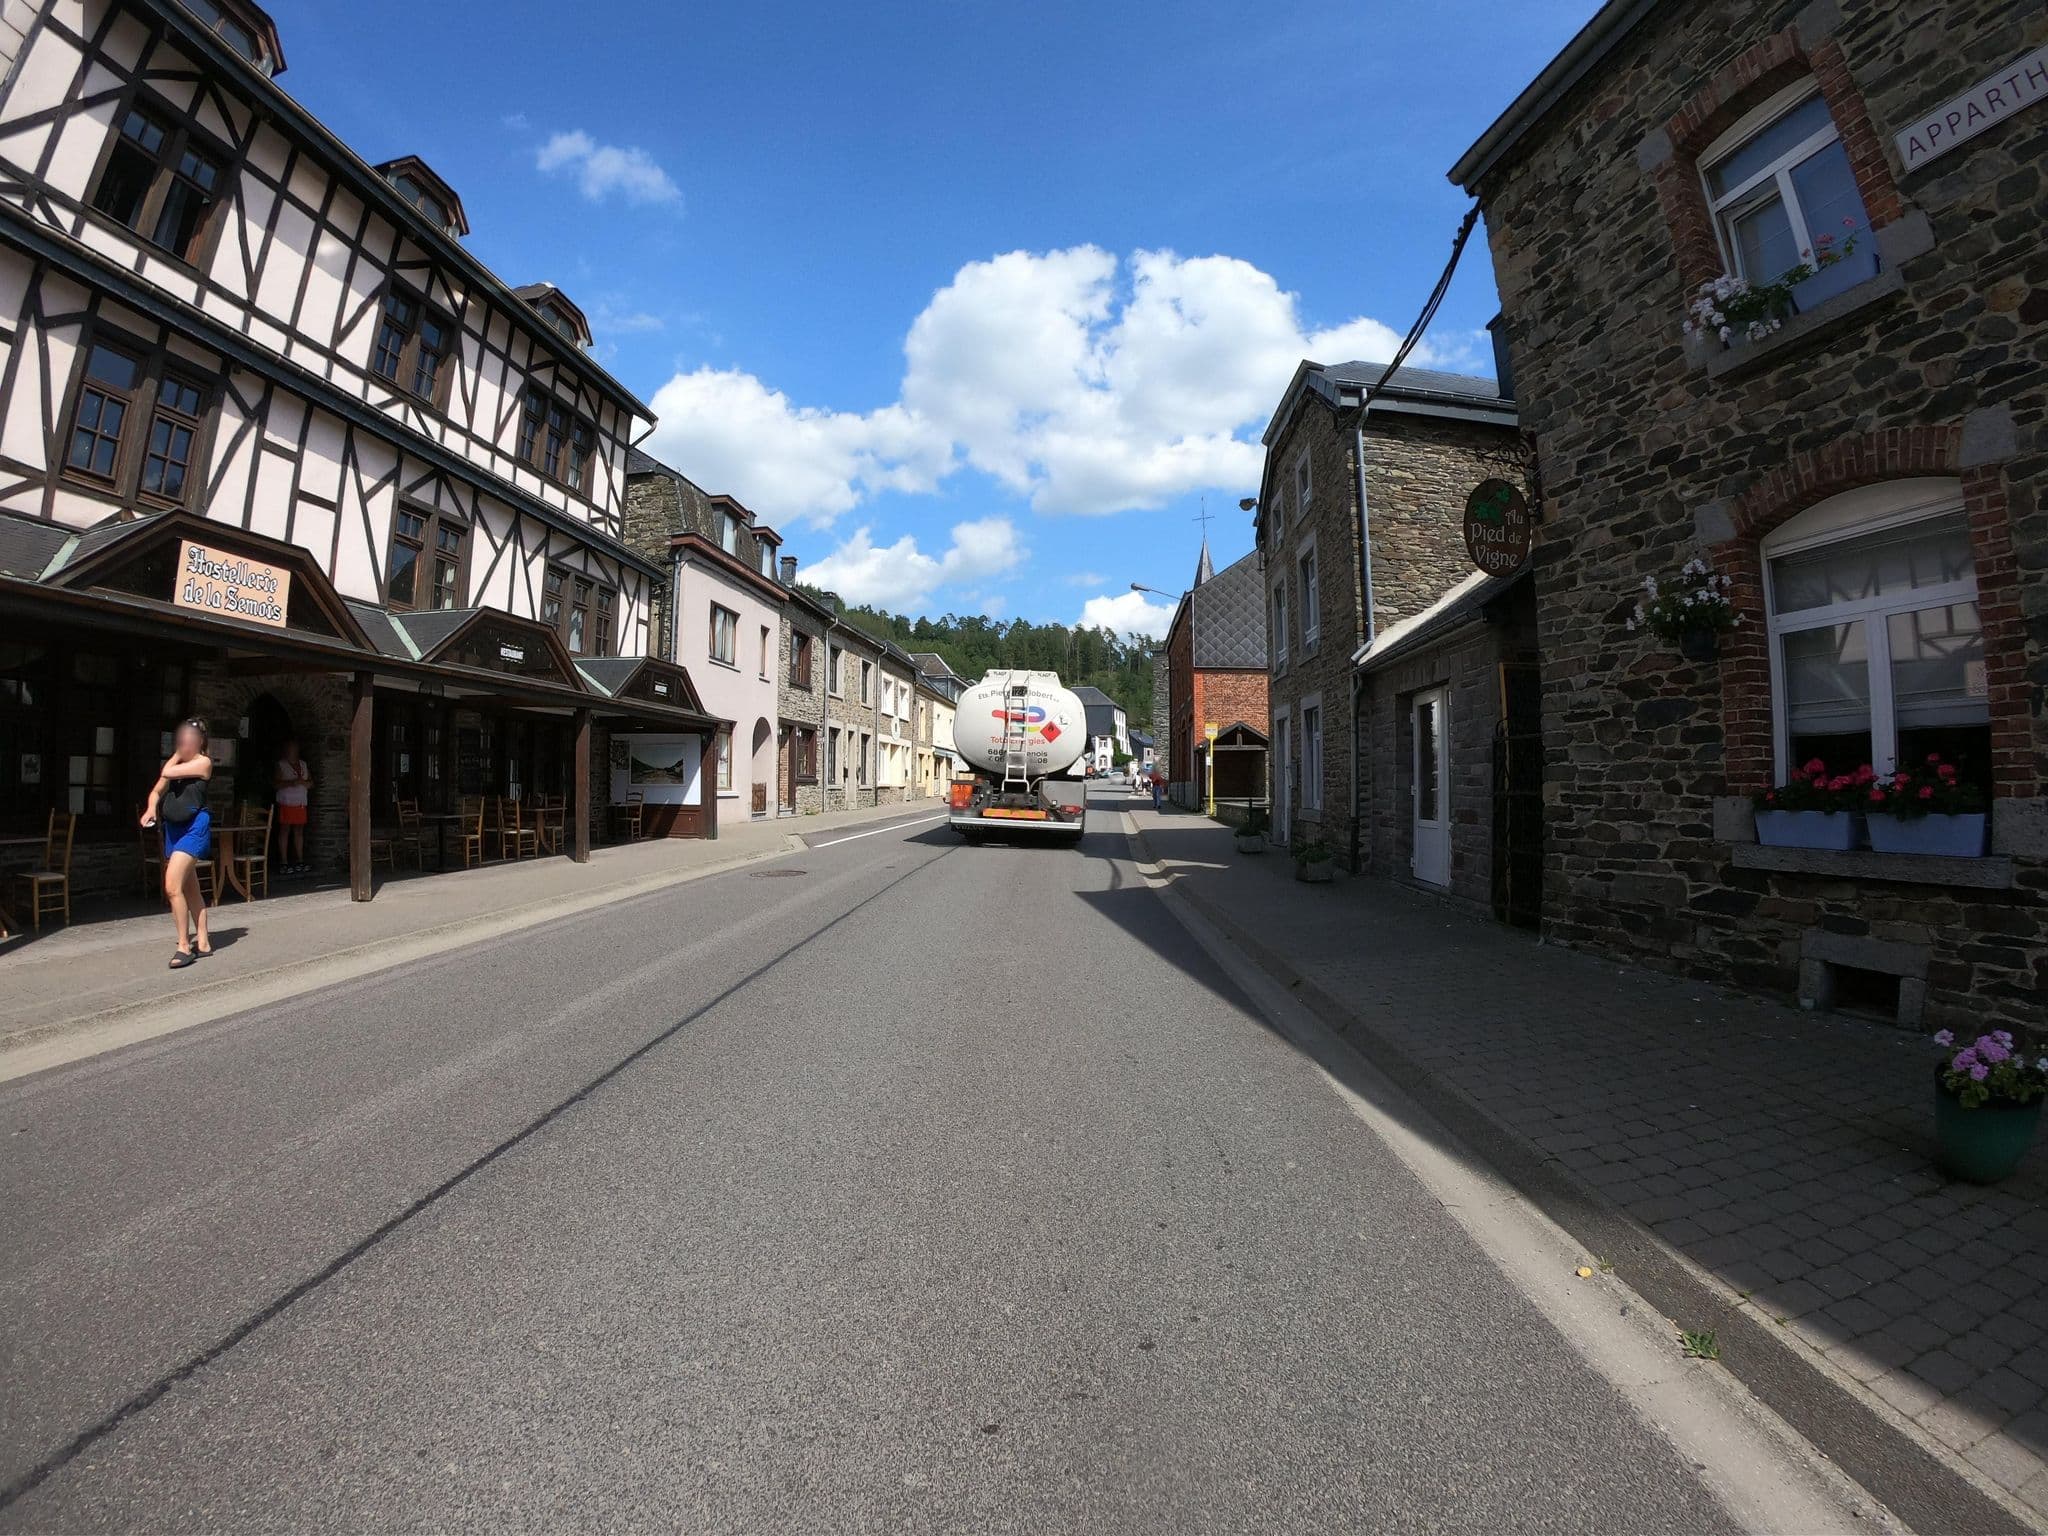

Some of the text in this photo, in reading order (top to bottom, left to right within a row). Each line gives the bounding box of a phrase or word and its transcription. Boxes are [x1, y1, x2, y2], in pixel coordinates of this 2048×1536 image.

[1909, 60, 2048, 161] APPARTH
[1470, 522, 1522, 544] Pied de
[1504, 509, 1524, 526] Au
[186, 546, 278, 593] Hostellerie
[1475, 545, 1519, 570] Vigne
[183, 578, 282, 621] de la Semois
